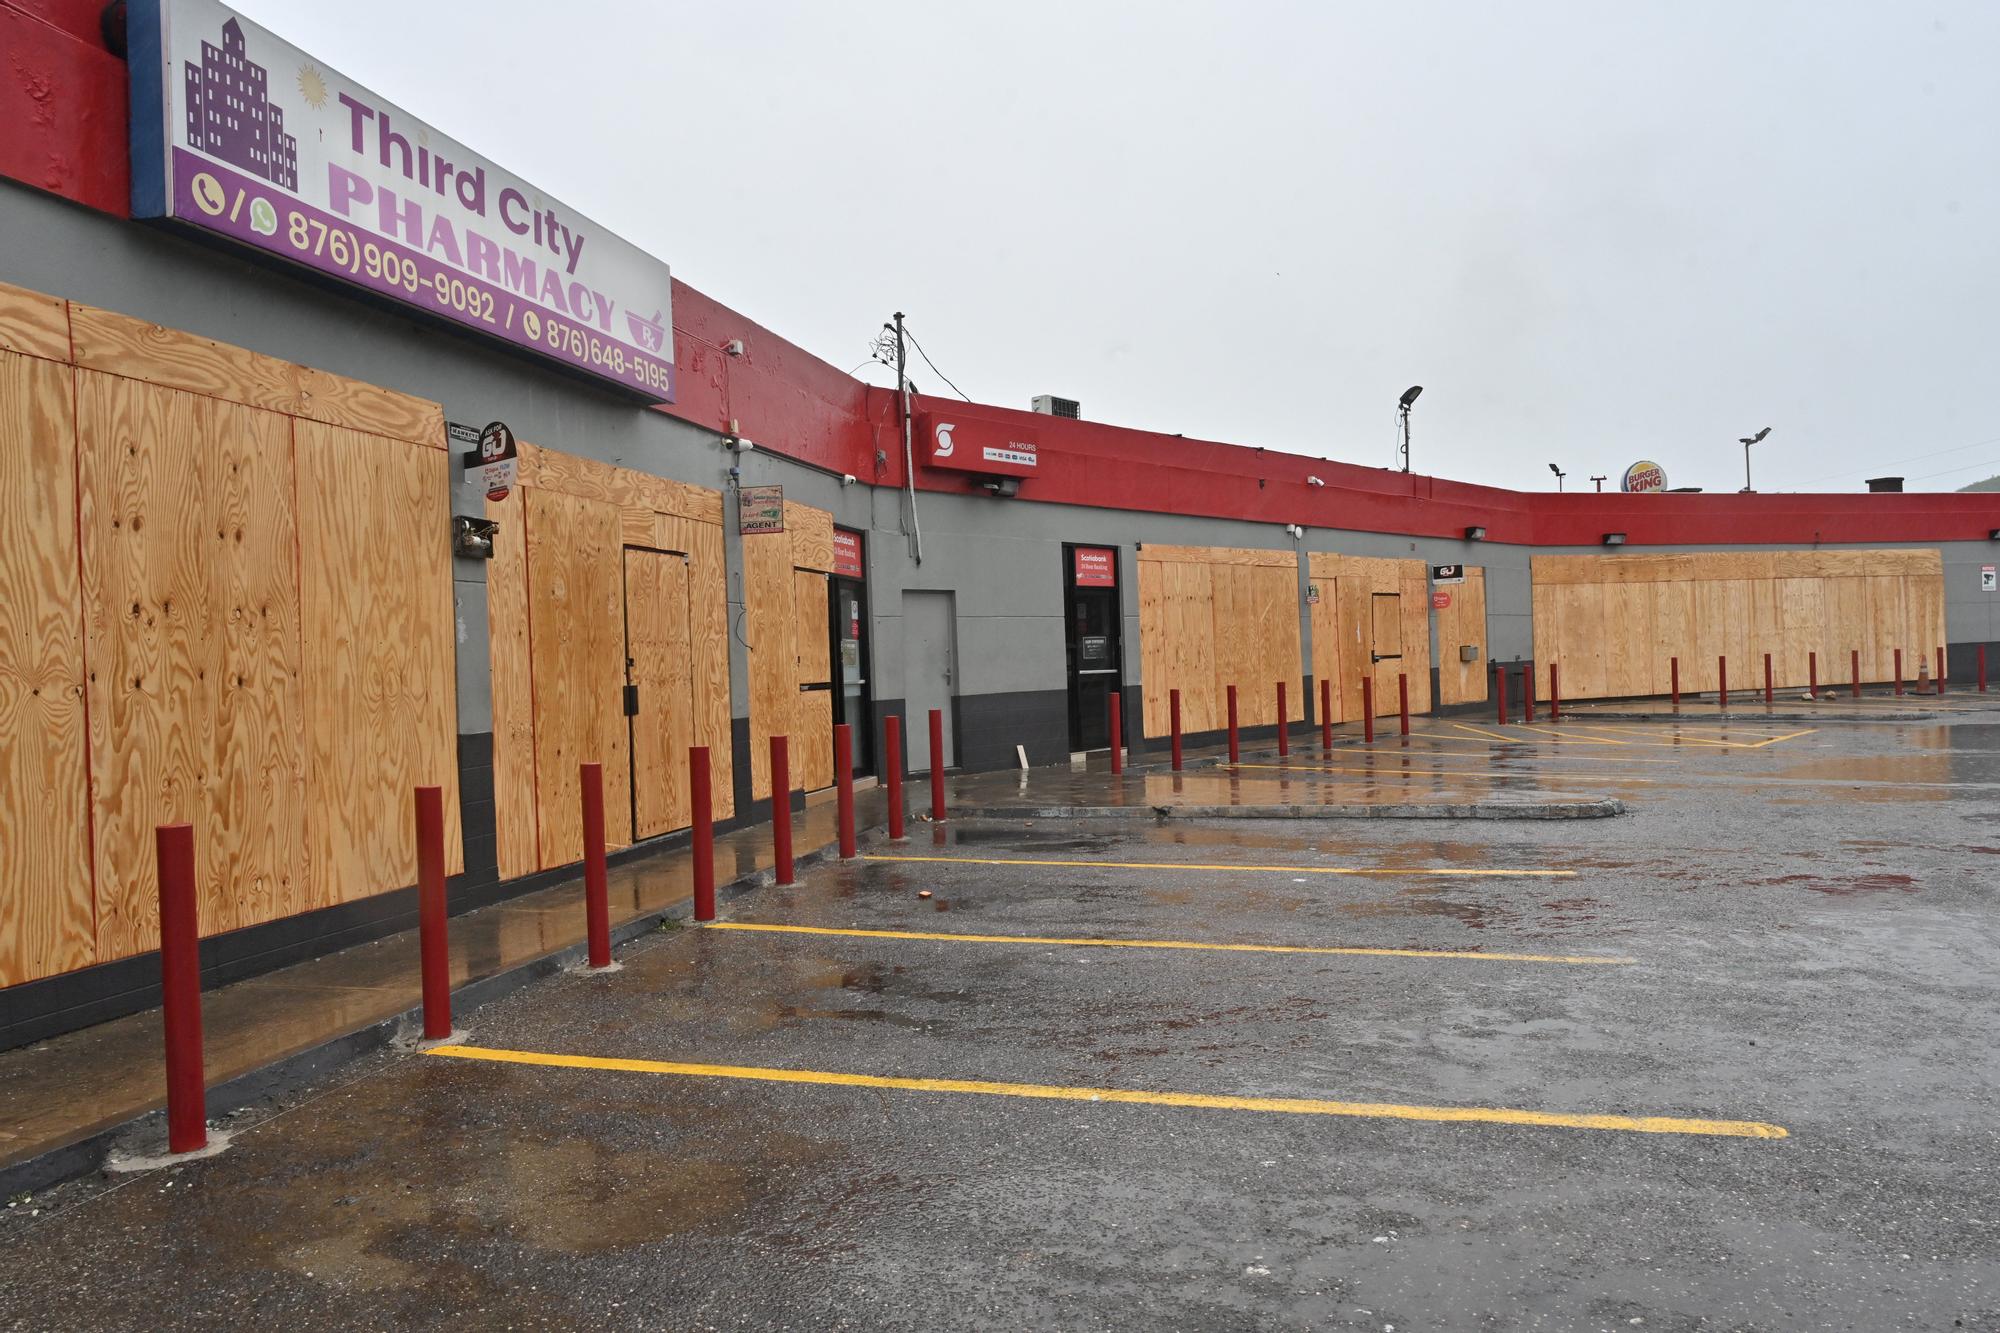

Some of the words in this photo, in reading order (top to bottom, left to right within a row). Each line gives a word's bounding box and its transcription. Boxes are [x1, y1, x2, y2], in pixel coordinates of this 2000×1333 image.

[338, 91, 486, 218] Third
[498, 187, 585, 275] City
[327, 161, 615, 333] PHARMACY
[288, 211, 496, 324] 876)909-9092
[547, 319, 669, 392] 876)648-5195
[1016, 442, 1037, 452] HOURS
[1629, 469, 1660, 484] BURGER
[1631, 475, 1661, 491] KING
[1081, 554, 1107, 562] Scotiabank
